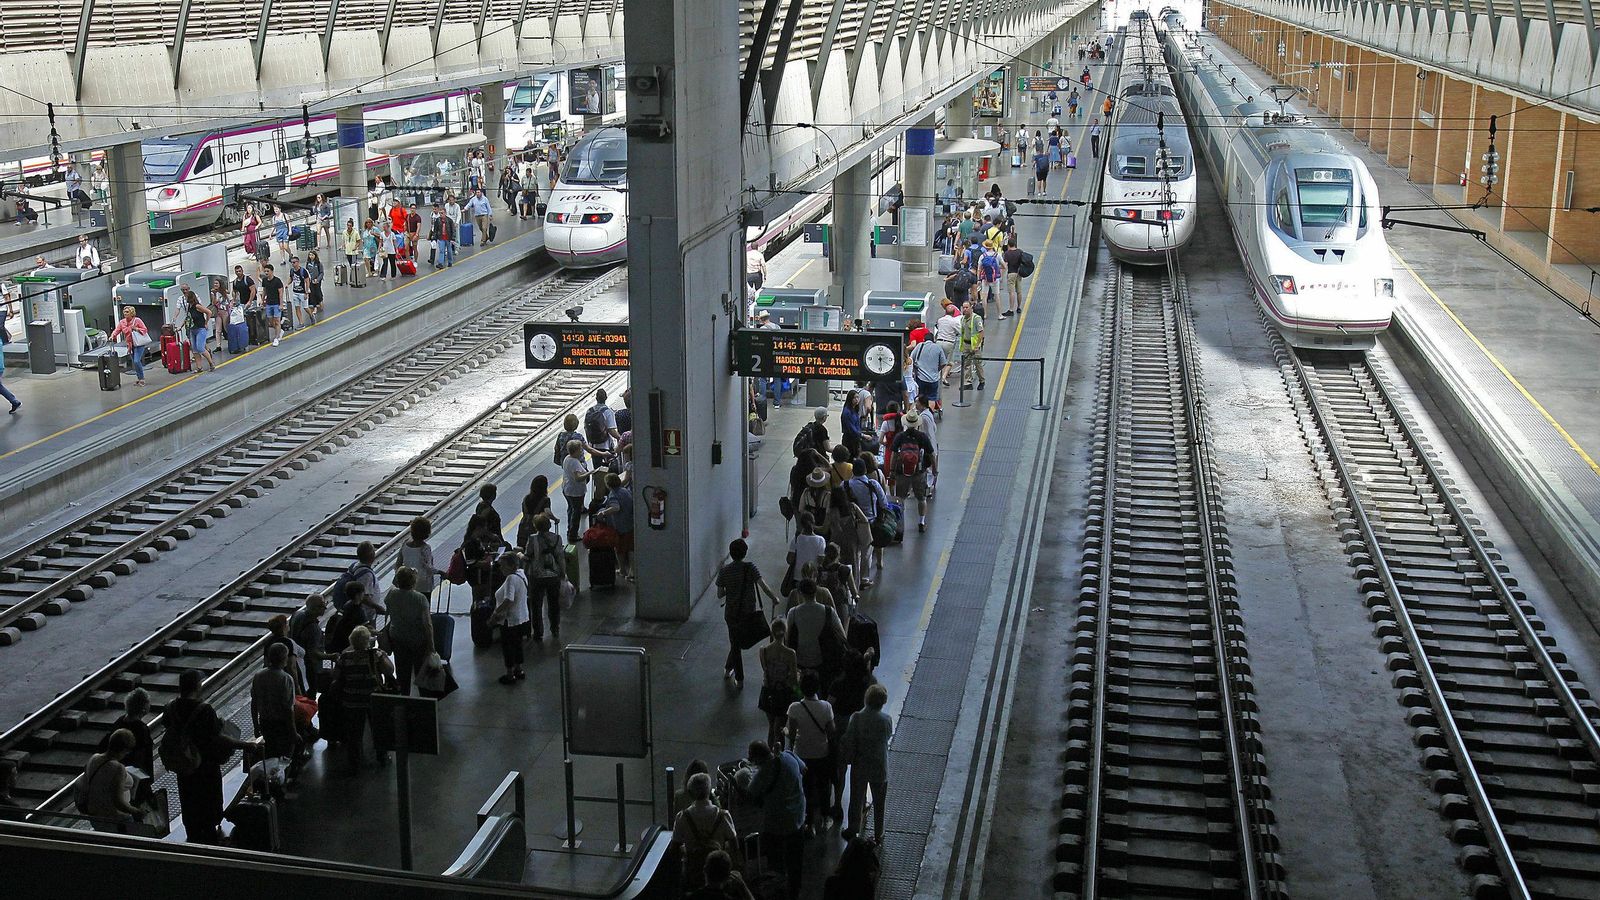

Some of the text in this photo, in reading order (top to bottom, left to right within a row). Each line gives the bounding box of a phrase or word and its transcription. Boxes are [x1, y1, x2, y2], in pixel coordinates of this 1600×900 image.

[222, 144, 250, 167] renfe
[560, 193, 601, 201] renfe
[90, 217, 96, 227] 5
[164, 219, 170, 229] 4
[805, 233, 810, 241] 3
[892, 236, 897, 244] 2
[562, 334, 627, 343] 14:50 AVE-03941
[773, 341, 841, 351] 14:45 AVE-02141
[751, 355, 761, 371] 2
[807, 357, 824, 366] PTA.
[830, 358, 858, 366] ATOCHA
[782, 365, 802, 374] PARA
[805, 366, 815, 374] EN
